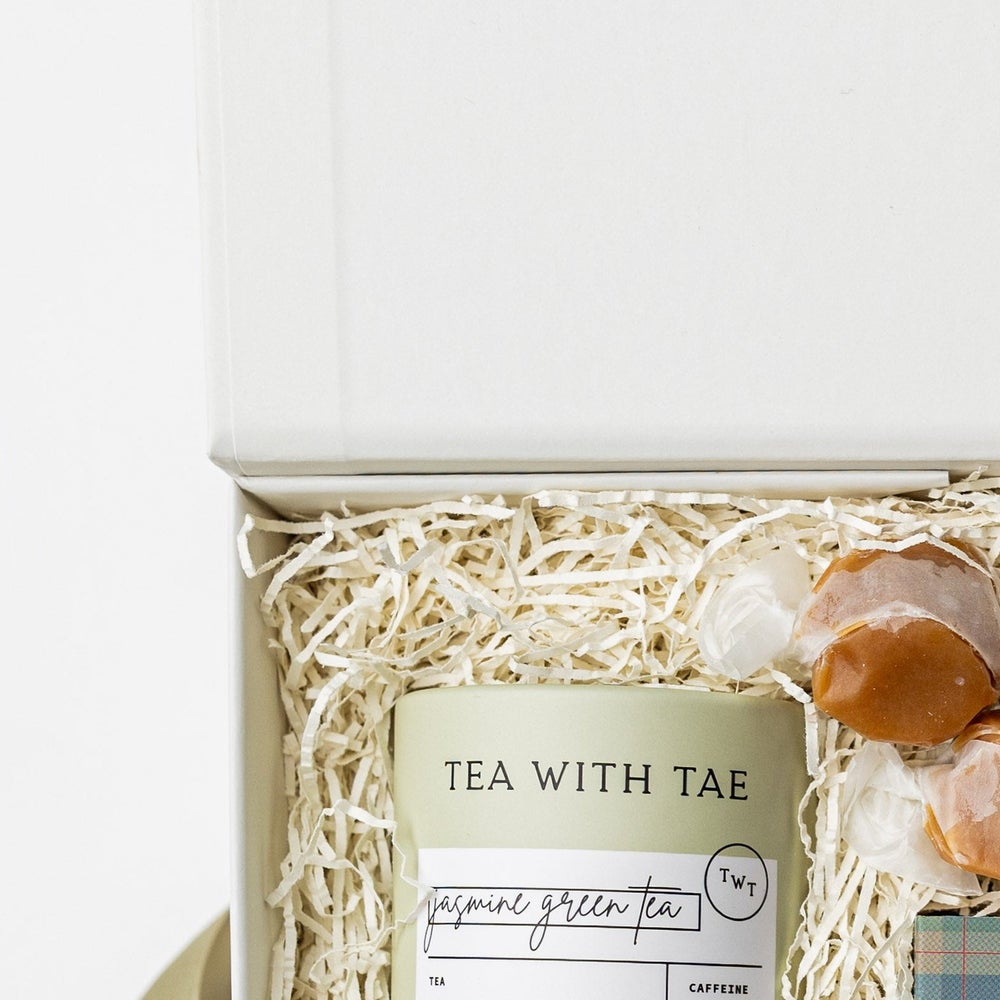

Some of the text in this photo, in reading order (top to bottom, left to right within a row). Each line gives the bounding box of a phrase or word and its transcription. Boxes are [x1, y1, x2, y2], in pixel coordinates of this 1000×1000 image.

[445, 760, 749, 800] TEA WITH TAE
[719, 868, 757, 897] TWT
[423, 875, 682, 953] jasmine green tea
[429, 977, 446, 987] TEA
[689, 983, 749, 995] CAFFEINE
